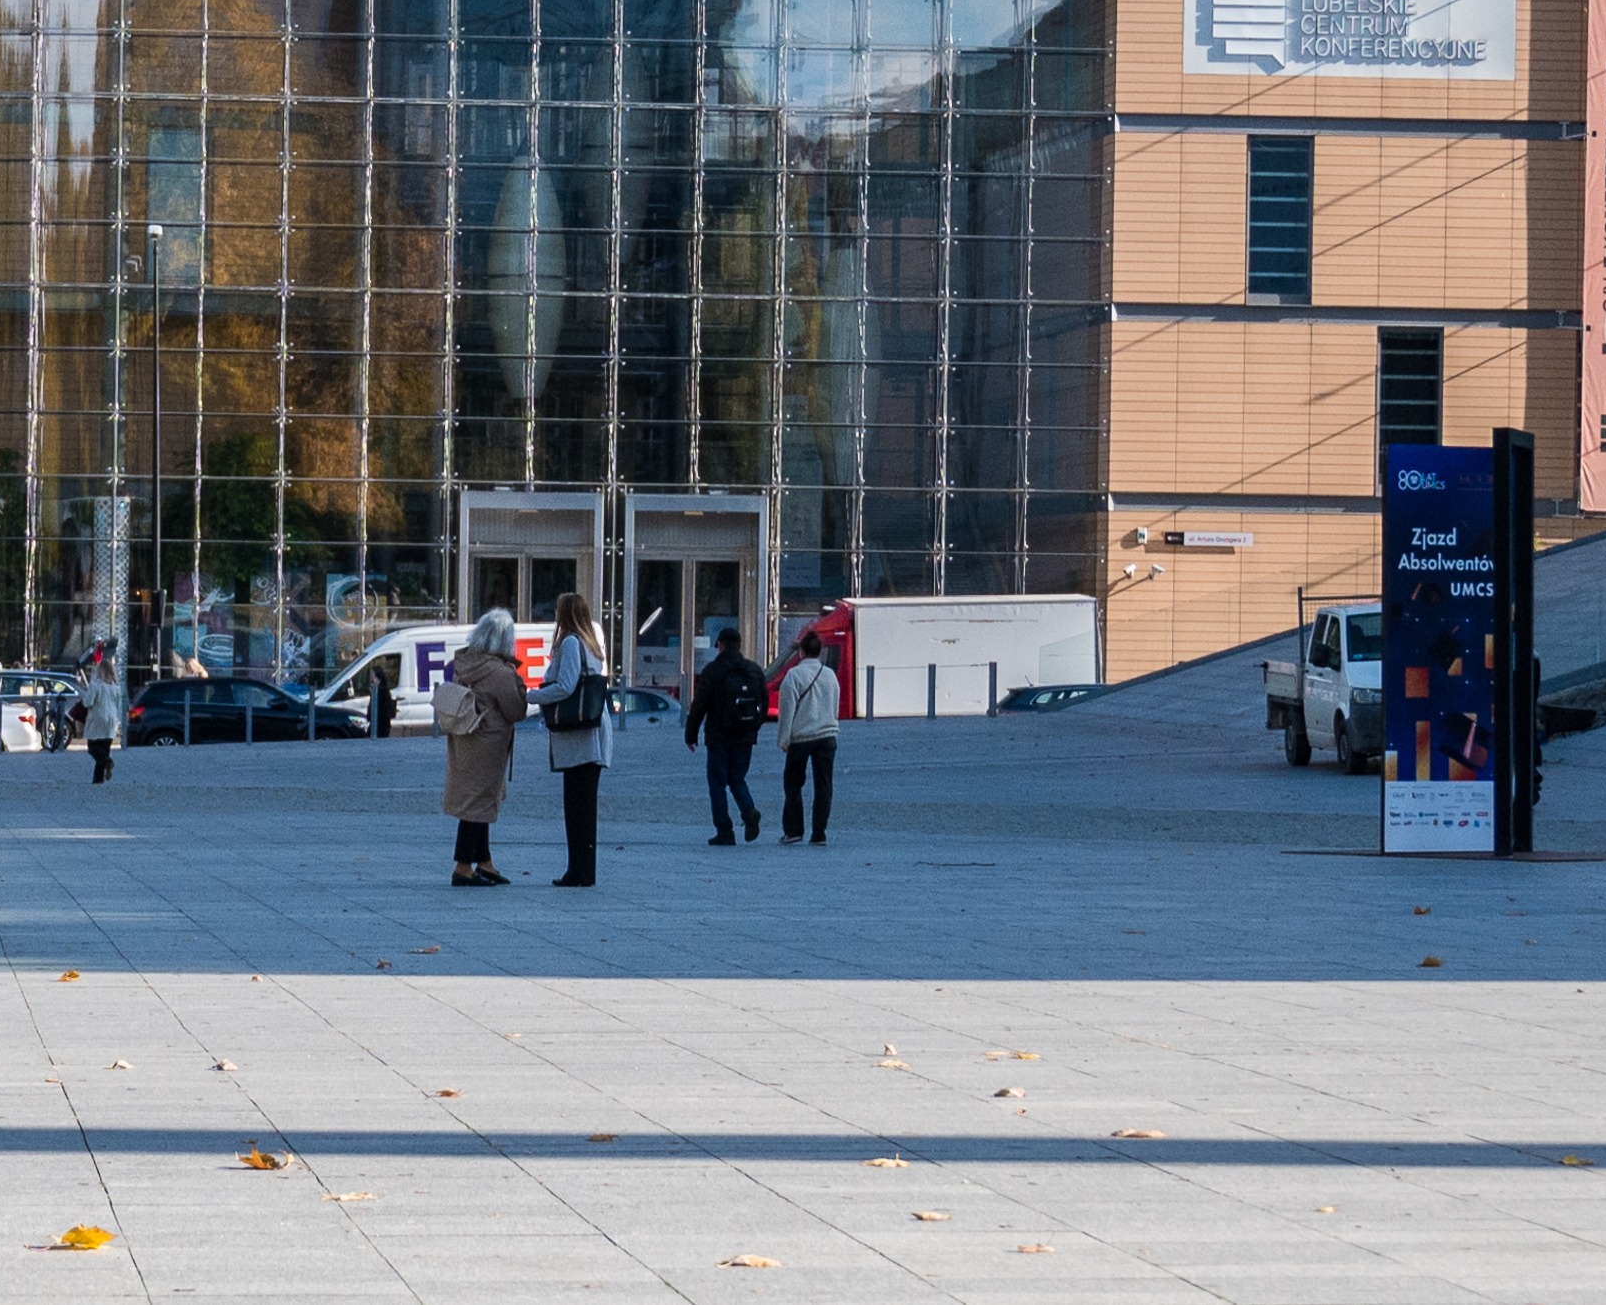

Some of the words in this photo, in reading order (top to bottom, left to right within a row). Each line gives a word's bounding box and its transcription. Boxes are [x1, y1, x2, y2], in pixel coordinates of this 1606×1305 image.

[1300, 15, 1410, 36] CENTRUM
[1300, 37, 1487, 60] KONFERENCYJNE
[1411, 527, 1457, 550] Zjazd
[1450, 582, 1494, 596] UMCS
